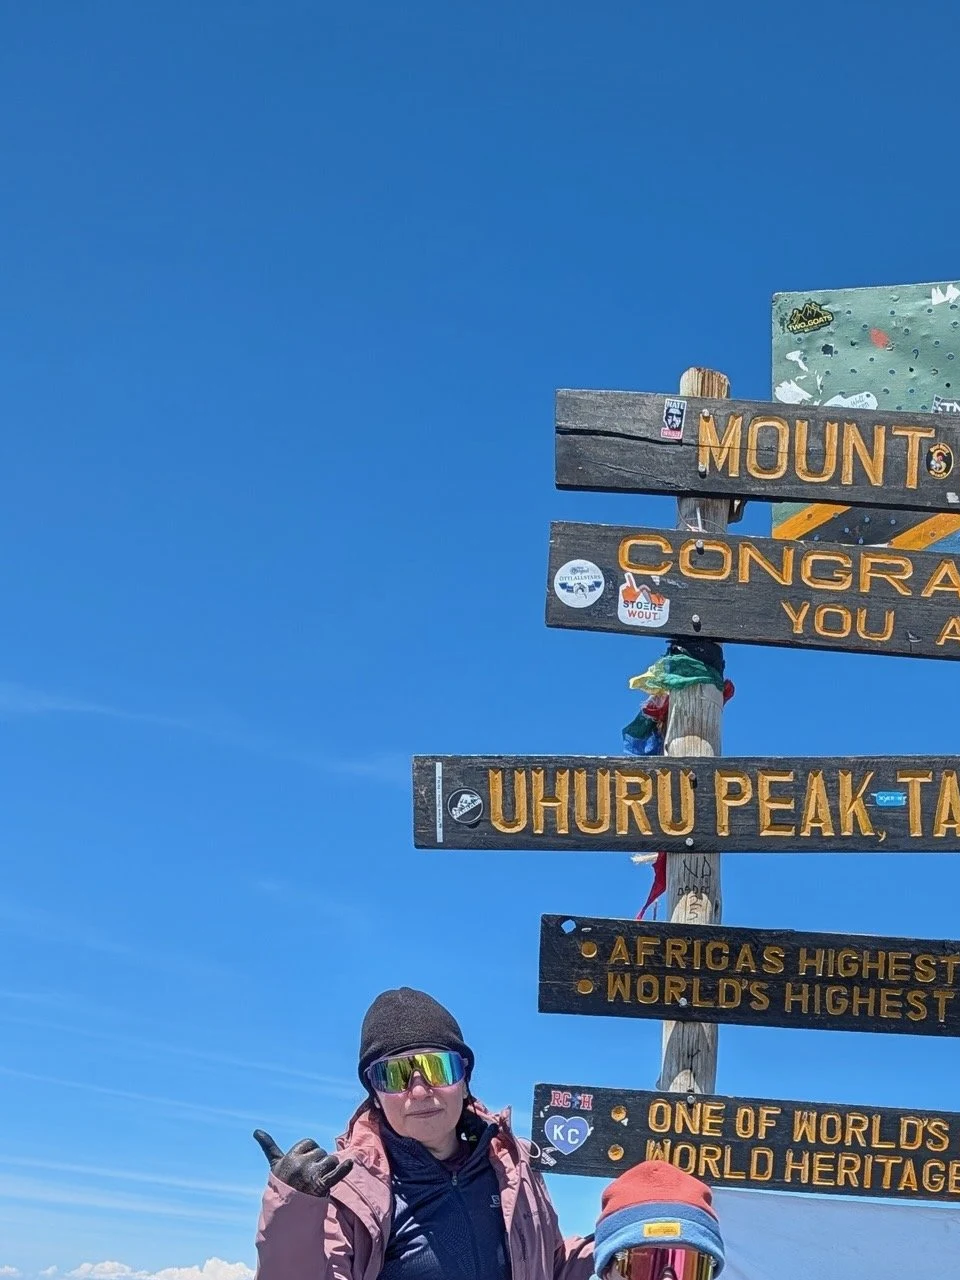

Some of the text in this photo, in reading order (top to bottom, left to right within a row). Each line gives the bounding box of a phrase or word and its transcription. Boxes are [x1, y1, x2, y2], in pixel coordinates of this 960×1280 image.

[699, 414, 935, 489] MOUNT
[623, 600, 663, 612] STOERE
[628, 609, 658, 620] WOUT
[780, 602, 895, 641] YOU
[488, 767, 695, 836] UHURU
[714, 768, 886, 842] PEAK,
[609, 936, 785, 974] AFRICAS
[607, 971, 770, 1011] WORLD'S
[784, 982, 955, 1023] HIGHEST
[553, 1124, 579, 1144] KC
[648, 1098, 726, 1137] ONE
[735, 1105, 782, 1140] OF
[793, 1109, 949, 1152] WORLD'S
[645, 1138, 774, 1182] WORLD
